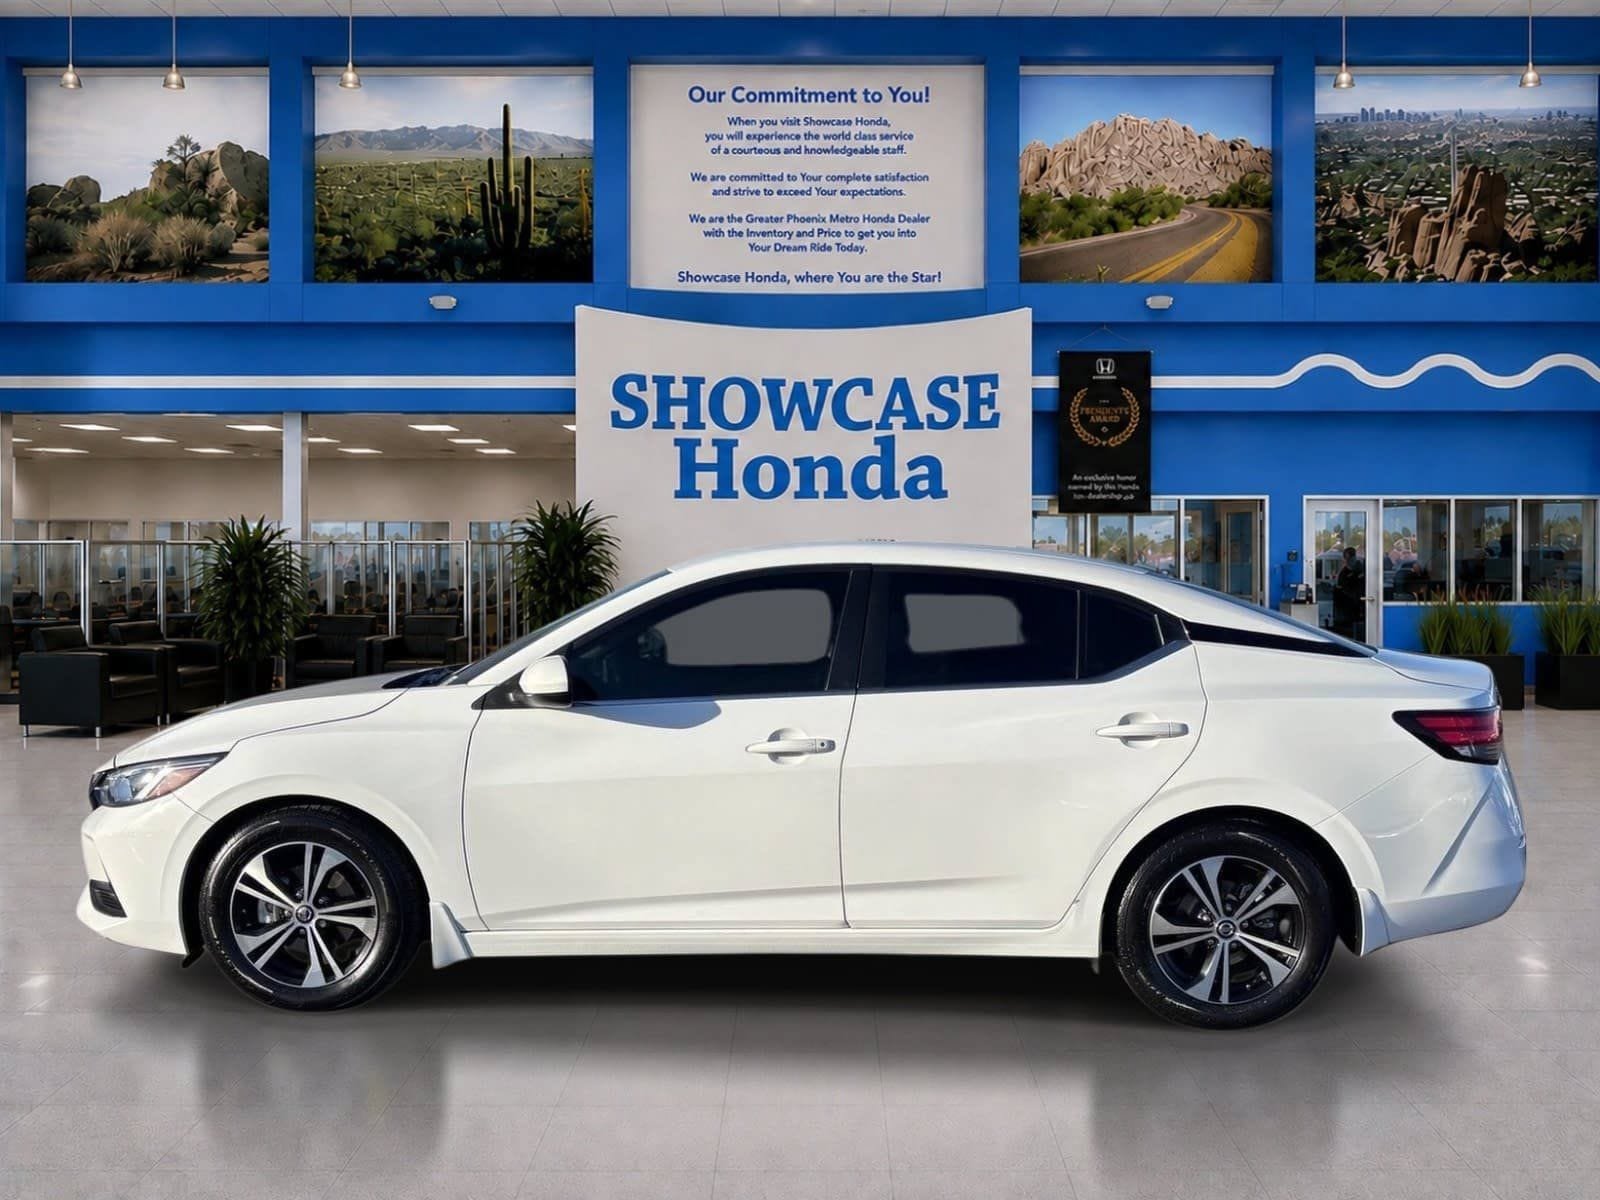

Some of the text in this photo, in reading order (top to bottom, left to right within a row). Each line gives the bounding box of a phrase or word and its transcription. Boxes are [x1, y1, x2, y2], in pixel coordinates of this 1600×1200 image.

[688, 86, 929, 103] Our Commitment to You!
[727, 116, 891, 129] When you visit Showcase Honda,
[704, 130, 914, 144] you will experience the world class service
[710, 144, 722, 155] of
[722, 147, 730, 155] a
[730, 146, 782, 156] courteous
[783, 144, 803, 155] and
[881, 144, 907, 155] staff.
[690, 171, 930, 185] We are committed to Your complete satisfaction
[711, 185, 906, 200] and strive to exceed Your expectations.
[688, 213, 931, 224] We are the Greater Phoenix Metro Honda Dealer
[702, 227, 917, 241] with the Inventory and Price to get you into
[748, 242, 868, 255] Your Dream Ride Today.
[677, 270, 942, 285] Showcase Honda, where You are the Star!
[611, 373, 1000, 431] SHOWCASE
[674, 435, 948, 500] Honda
